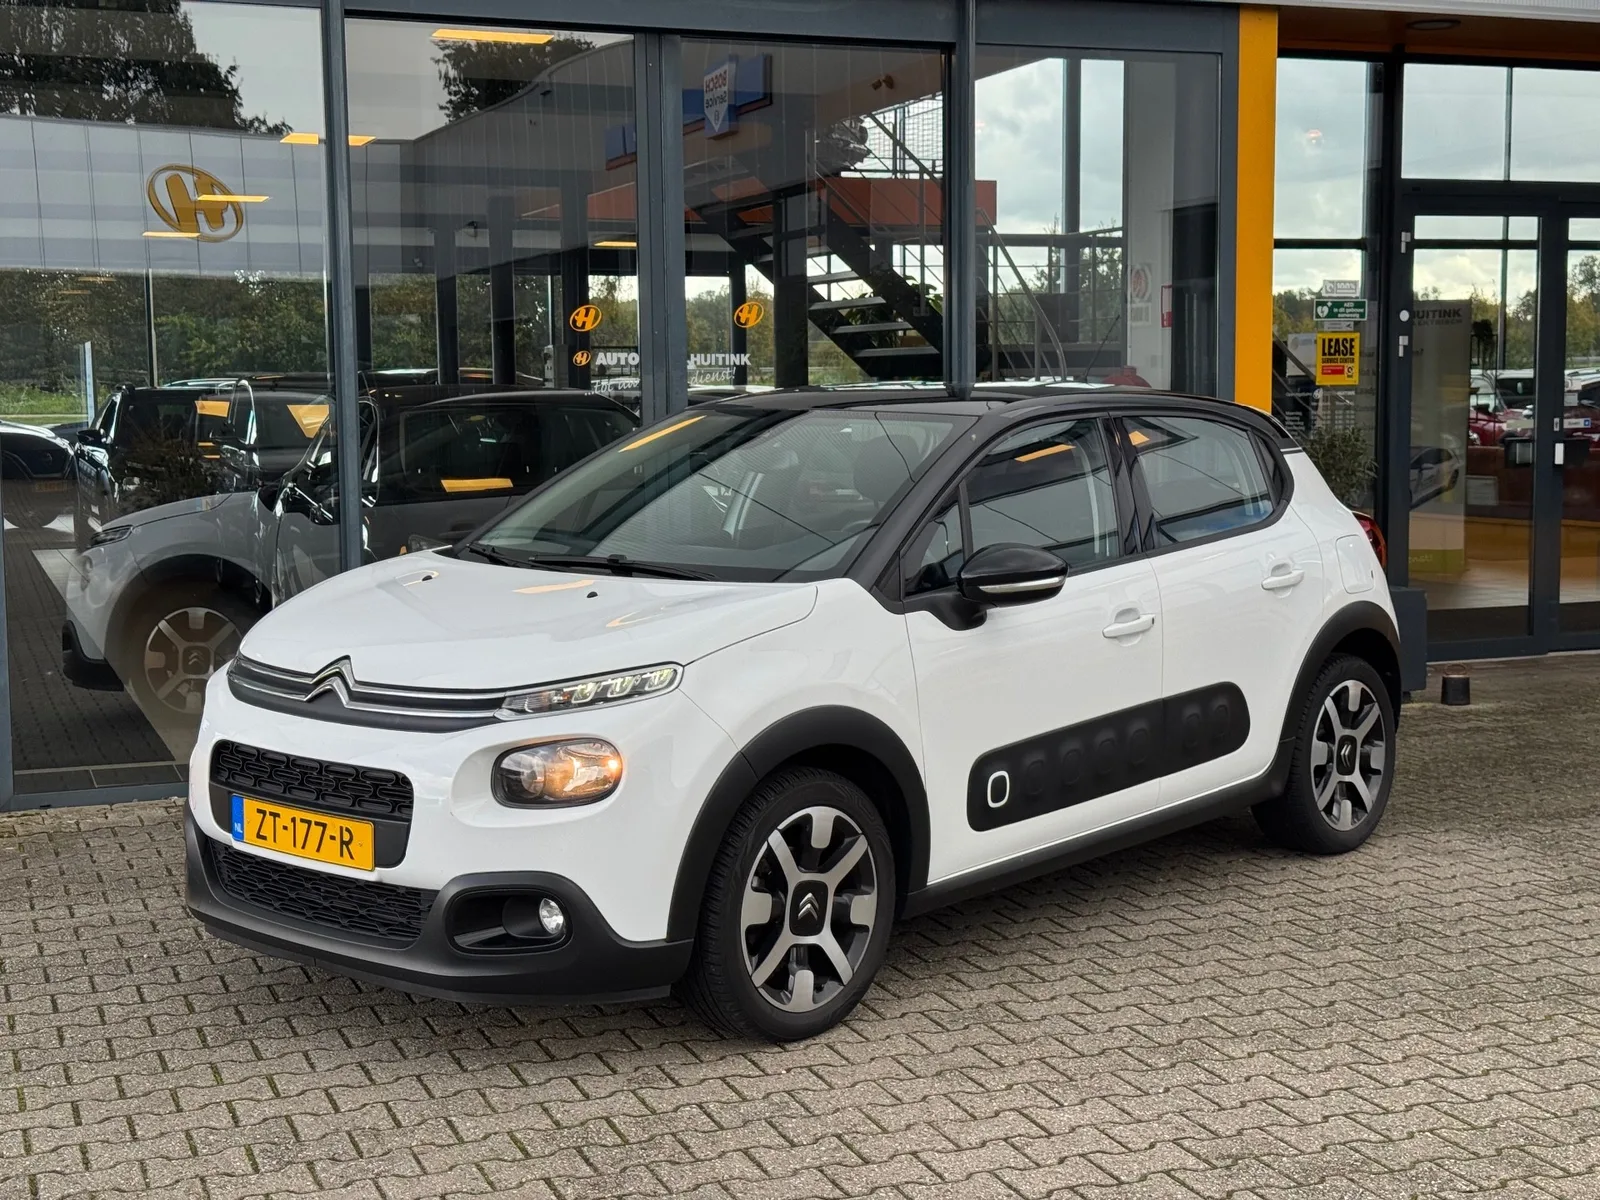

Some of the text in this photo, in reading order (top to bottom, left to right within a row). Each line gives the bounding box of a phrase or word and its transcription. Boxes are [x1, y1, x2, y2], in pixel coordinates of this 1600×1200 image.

[1322, 338, 1355, 357] LEASE
[596, 352, 640, 366] AUTO
[690, 353, 752, 366] HUITINK
[690, 366, 737, 385] dienst!
[234, 822, 243, 834] NL
[255, 807, 355, 860] ZT-177-R
